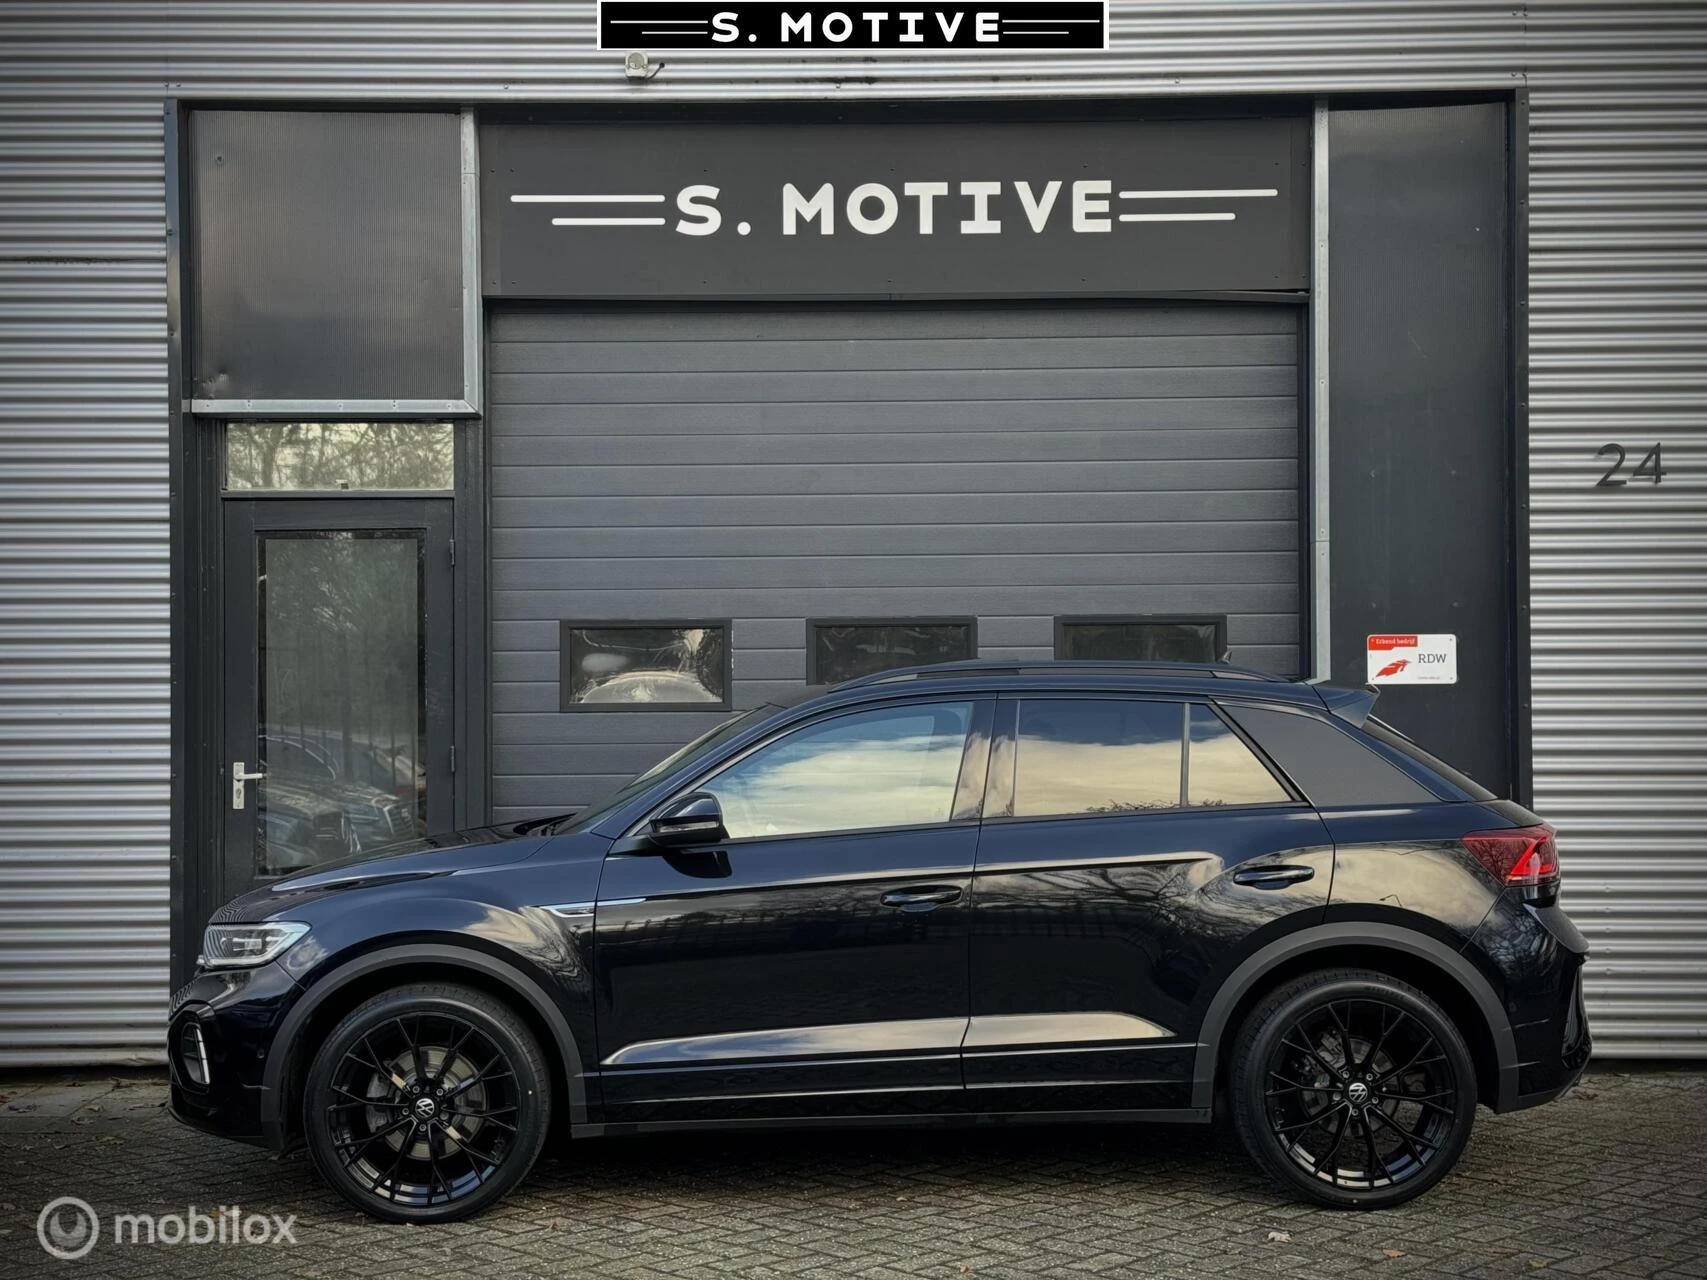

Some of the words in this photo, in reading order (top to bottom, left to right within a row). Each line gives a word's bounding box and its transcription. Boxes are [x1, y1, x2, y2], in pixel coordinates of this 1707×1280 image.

[675, 184, 752, 236] S.
[782, 180, 1112, 236] MOTIVE
[1596, 442, 1667, 487] 24
[1418, 653, 1447, 664] RDW
